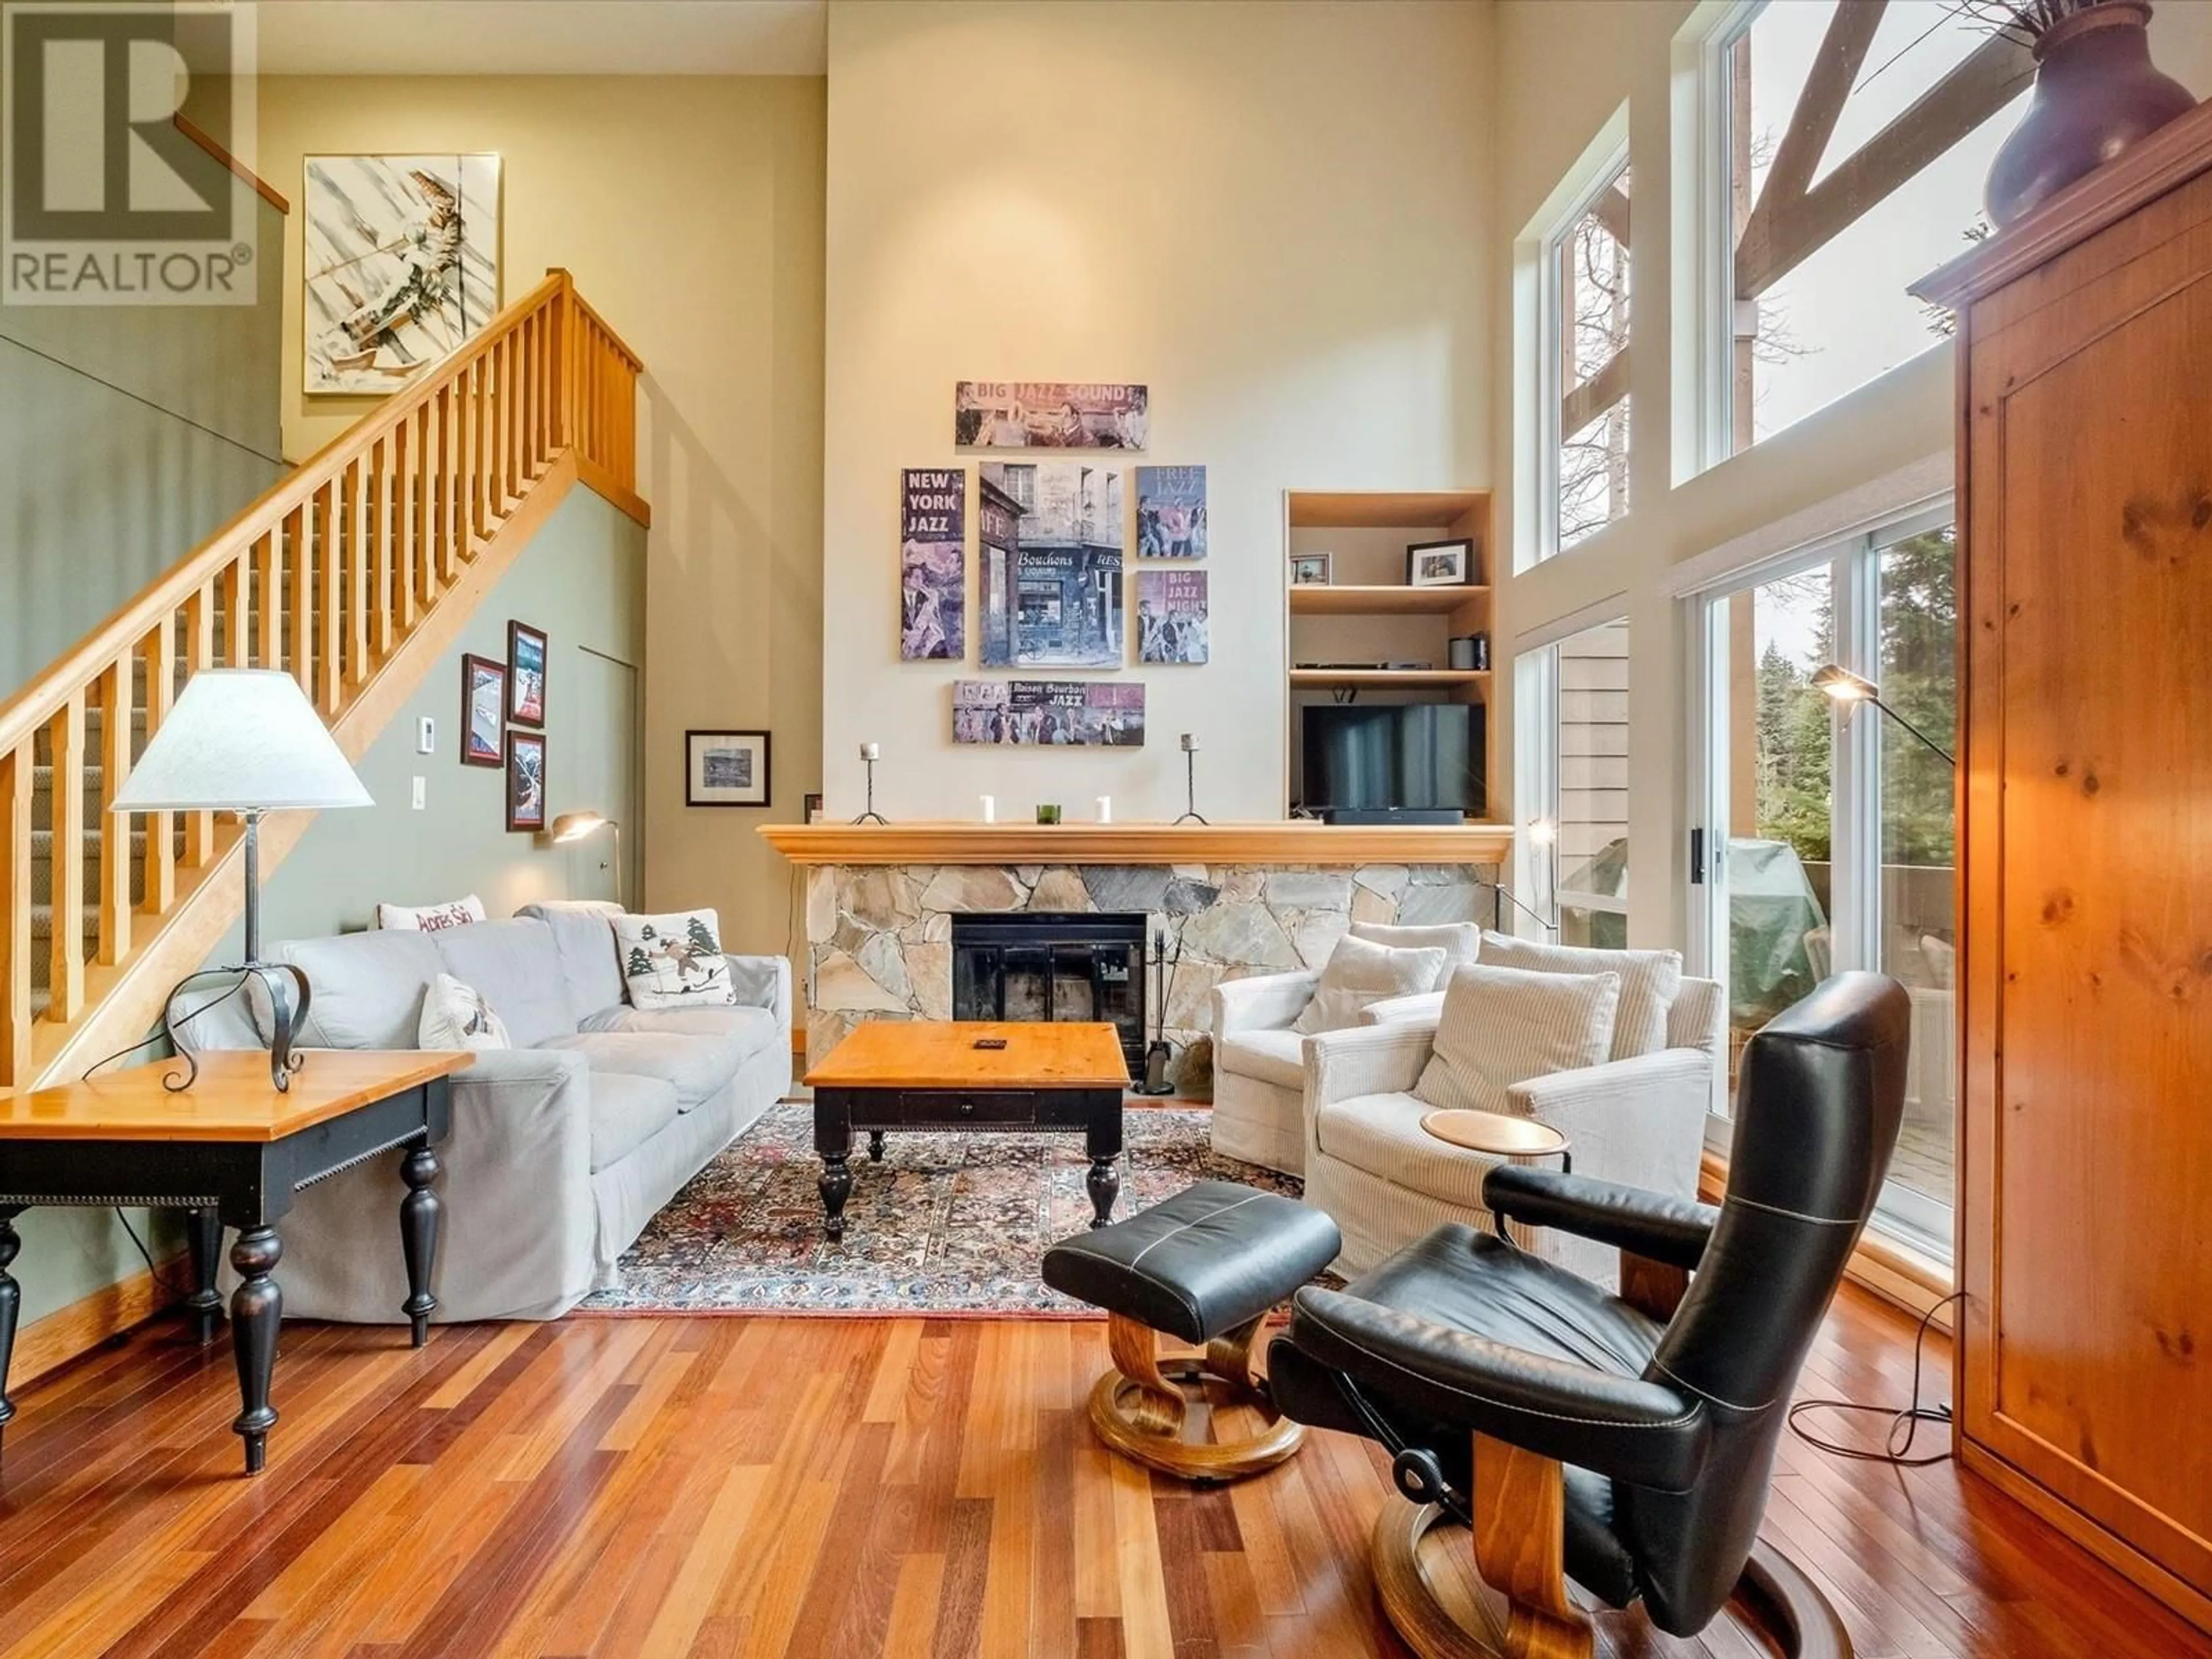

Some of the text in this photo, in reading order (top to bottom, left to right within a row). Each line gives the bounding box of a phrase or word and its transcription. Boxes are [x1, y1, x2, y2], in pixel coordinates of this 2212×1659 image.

[978, 384, 1125, 402] BIG JAZZ SOUND
[909, 473, 949, 488] NEW
[910, 495, 956, 510] YORK
[909, 517, 949, 532] JAZZ
[1018, 551, 1073, 566] Bouchons
[1169, 572, 1191, 584] BIG
[1169, 586, 1198, 599] JAZZ
[1167, 600, 1206, 612] NIGHT
[1048, 695, 1083, 706] JAZZ
